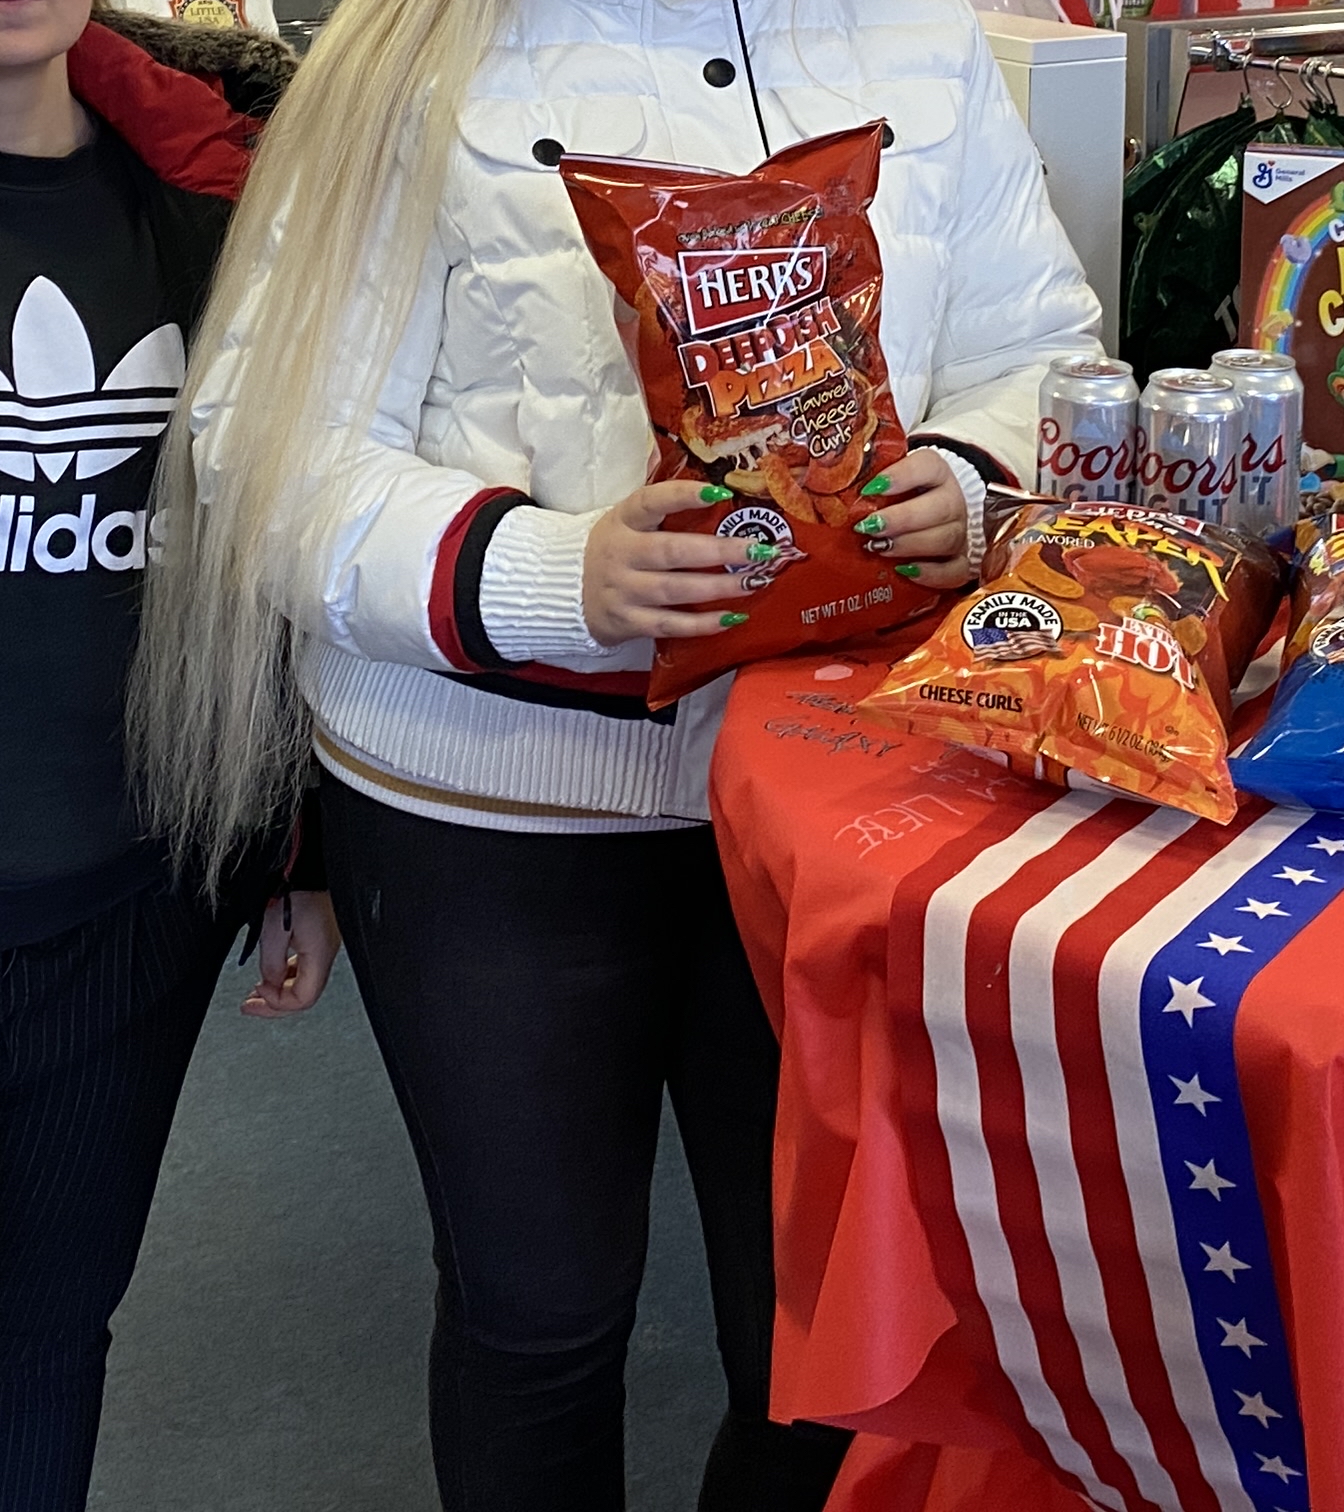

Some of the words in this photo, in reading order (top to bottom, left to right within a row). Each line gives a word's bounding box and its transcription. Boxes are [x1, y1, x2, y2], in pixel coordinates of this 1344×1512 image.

[190, 7, 224, 16] LITTLE
[706, 338, 846, 418] PIZZA
[790, 380, 851, 415] flavored
[791, 400, 857, 438] Cheese
[809, 424, 853, 457] Curls
[1137, 426, 1238, 497] Coors
[749, 509, 787, 534] MADE
[801, 606, 820, 624] NET
[821, 601, 837, 618] WT
[839, 599, 845, 613] 7
[967, 595, 1017, 627] FAMILY
[1020, 595, 1058, 626] MADE
[995, 616, 1032, 629] USA
[1095, 622, 1195, 690] HOT
[919, 683, 974, 707] CHEESE
[976, 692, 1024, 713] CURLS
[1077, 711, 1094, 732] NET
